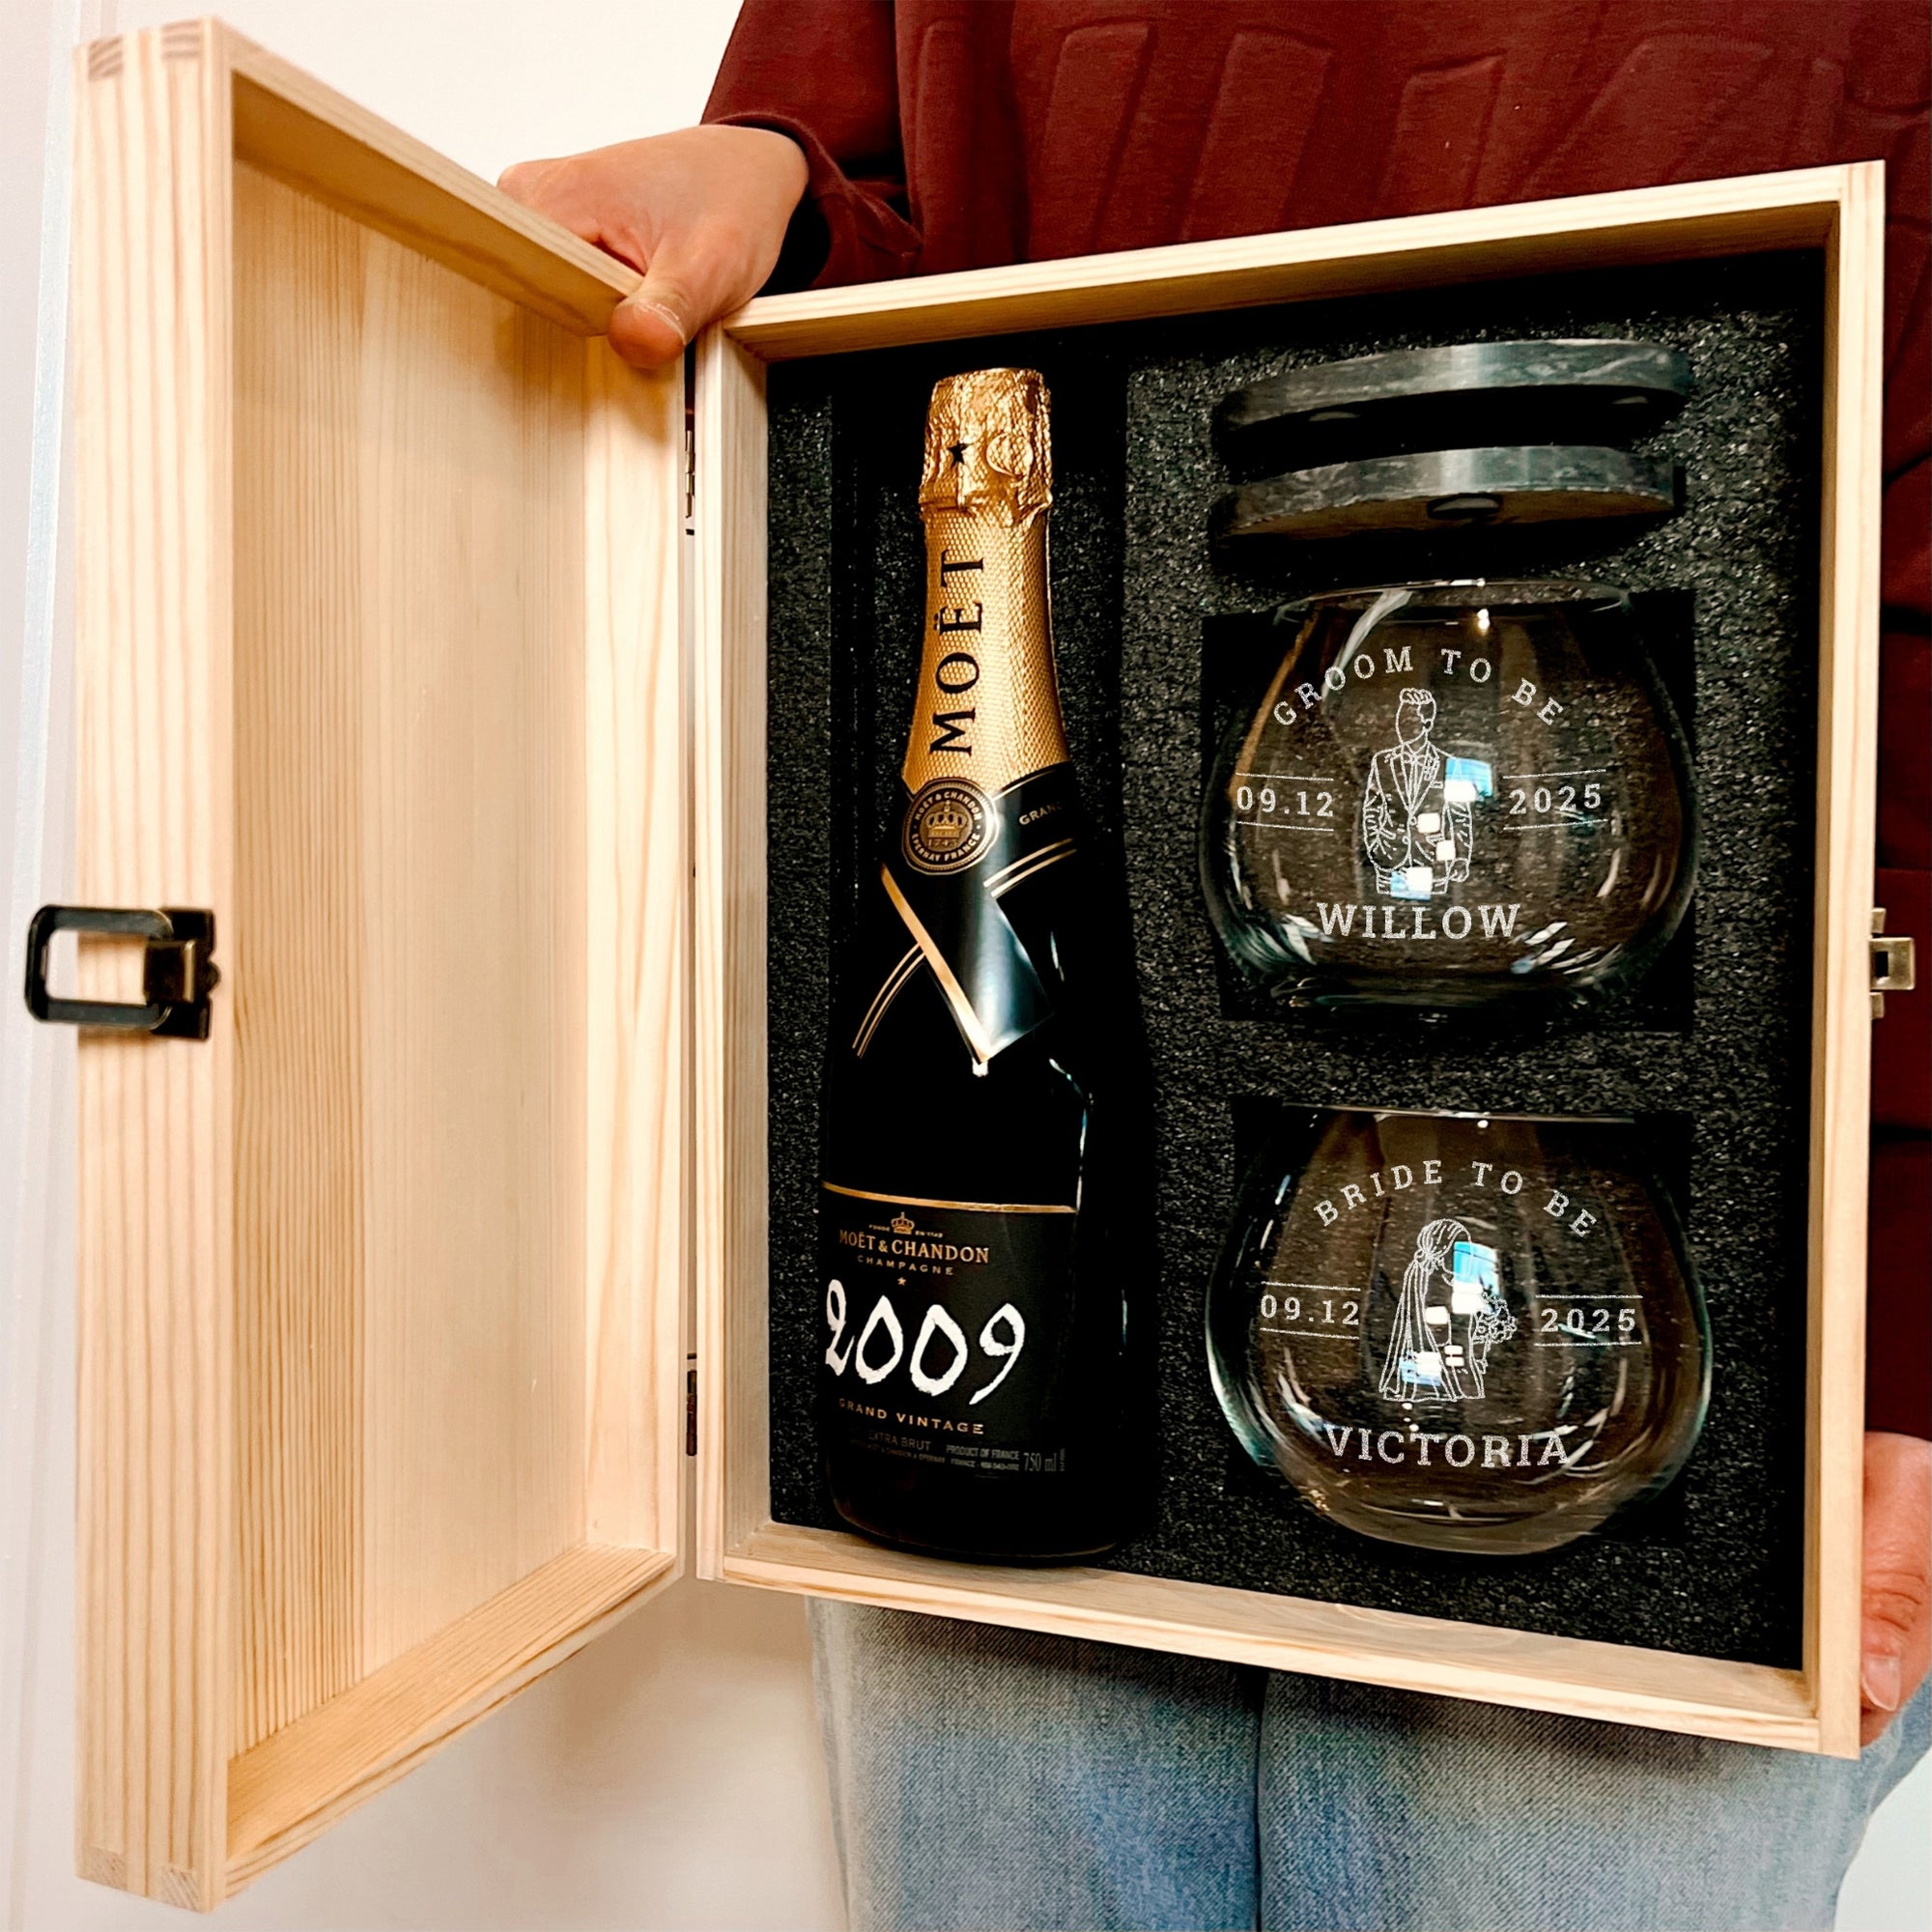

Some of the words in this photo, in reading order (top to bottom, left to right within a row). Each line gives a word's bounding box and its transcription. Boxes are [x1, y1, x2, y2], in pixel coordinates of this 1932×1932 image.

[928, 549, 983, 756] MOËT
[1273, 646, 1413, 726] GROOM
[1441, 648, 1492, 683] TO
[1512, 678, 1564, 726] BE
[943, 791, 982, 821] CHANDON
[1236, 785, 1334, 817] 09.12
[1509, 783, 1602, 815] 2025
[944, 833, 981, 862] FRANCE
[1317, 902, 1520, 940] WILLOW
[1314, 1160, 1443, 1227] BRIDE
[1470, 1162, 1523, 1195] TO
[1543, 1190, 1598, 1237] BE
[857, 1255, 953, 1275] CHAMPAGNE
[878, 1239, 888, 1253] &
[892, 1239, 990, 1264] CHANDON
[1260, 1294, 1360, 1325] 09.12
[1540, 1307, 1635, 1332] 2025
[825, 1279, 1025, 1405] 2009
[838, 1398, 888, 1420] GRAND
[896, 1412, 984, 1435] VINTAGE
[900, 1436, 932, 1451] BRUT
[1324, 1425, 1570, 1467] VICTORIA
[1023, 1452, 1042, 1472] 750
